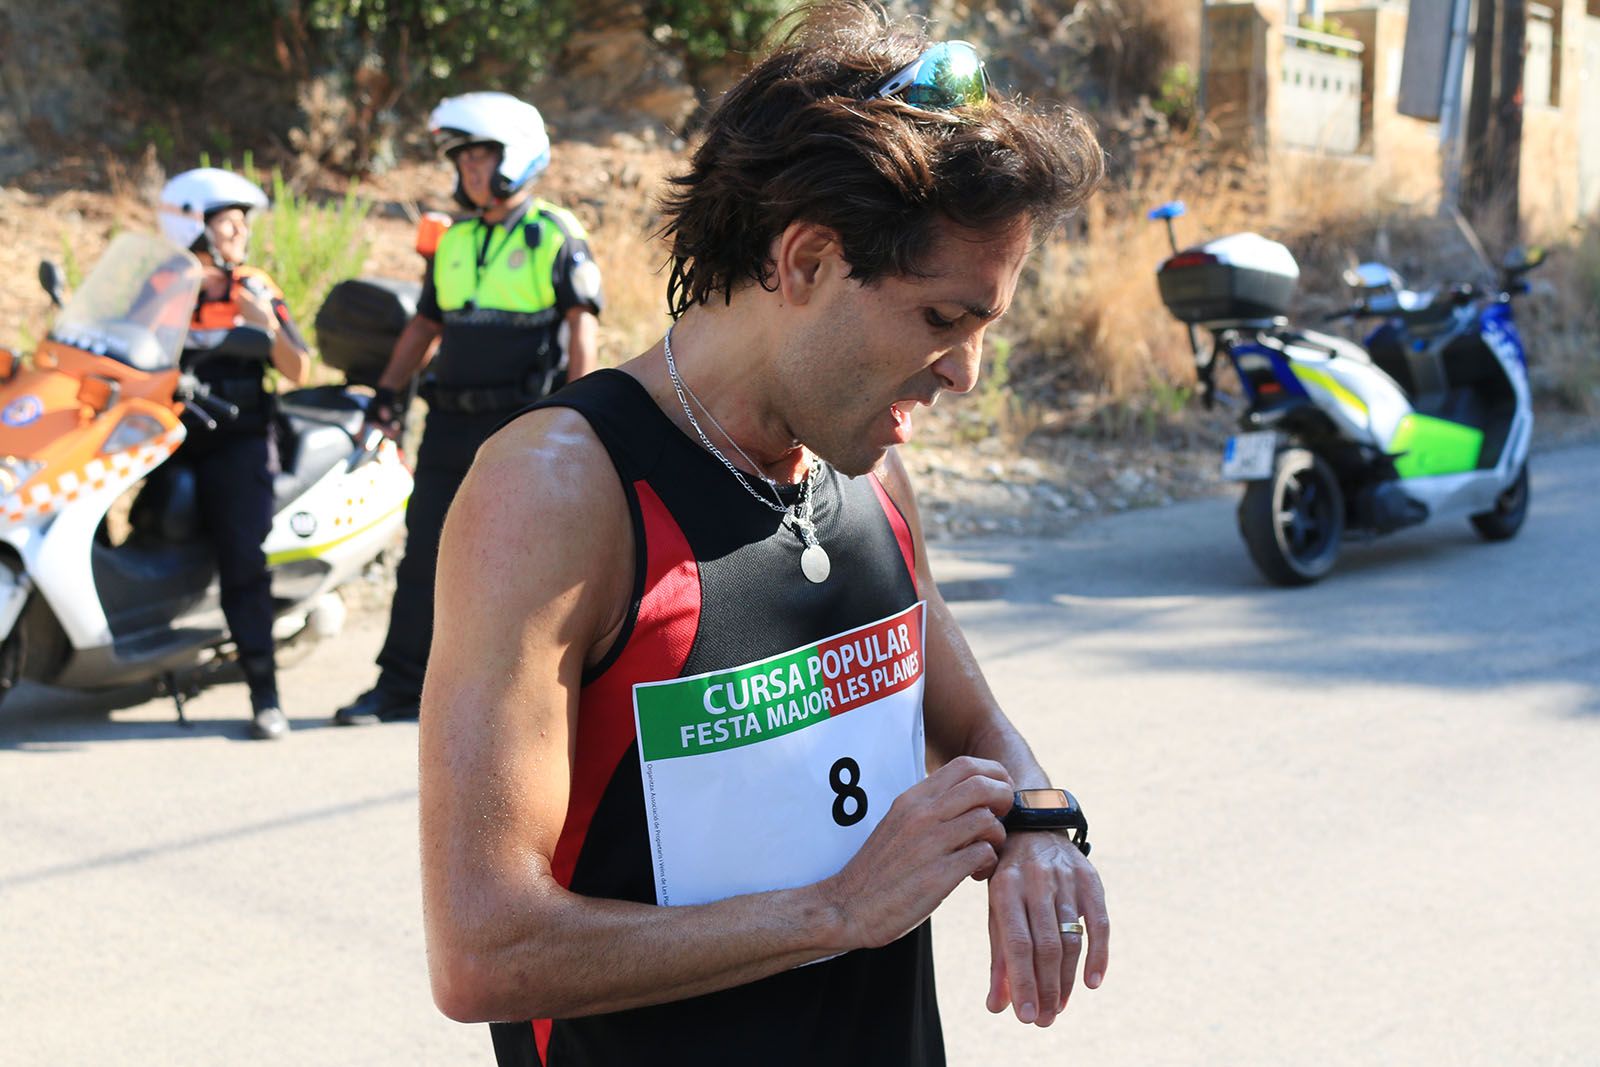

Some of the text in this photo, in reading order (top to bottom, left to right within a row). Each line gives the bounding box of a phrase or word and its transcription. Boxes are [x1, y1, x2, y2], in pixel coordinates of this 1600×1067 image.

[680, 650, 919, 748] FESTA MAJOR LES PLANES
[703, 624, 911, 715] CURSA POPULAR
[829, 757, 868, 827] 8
